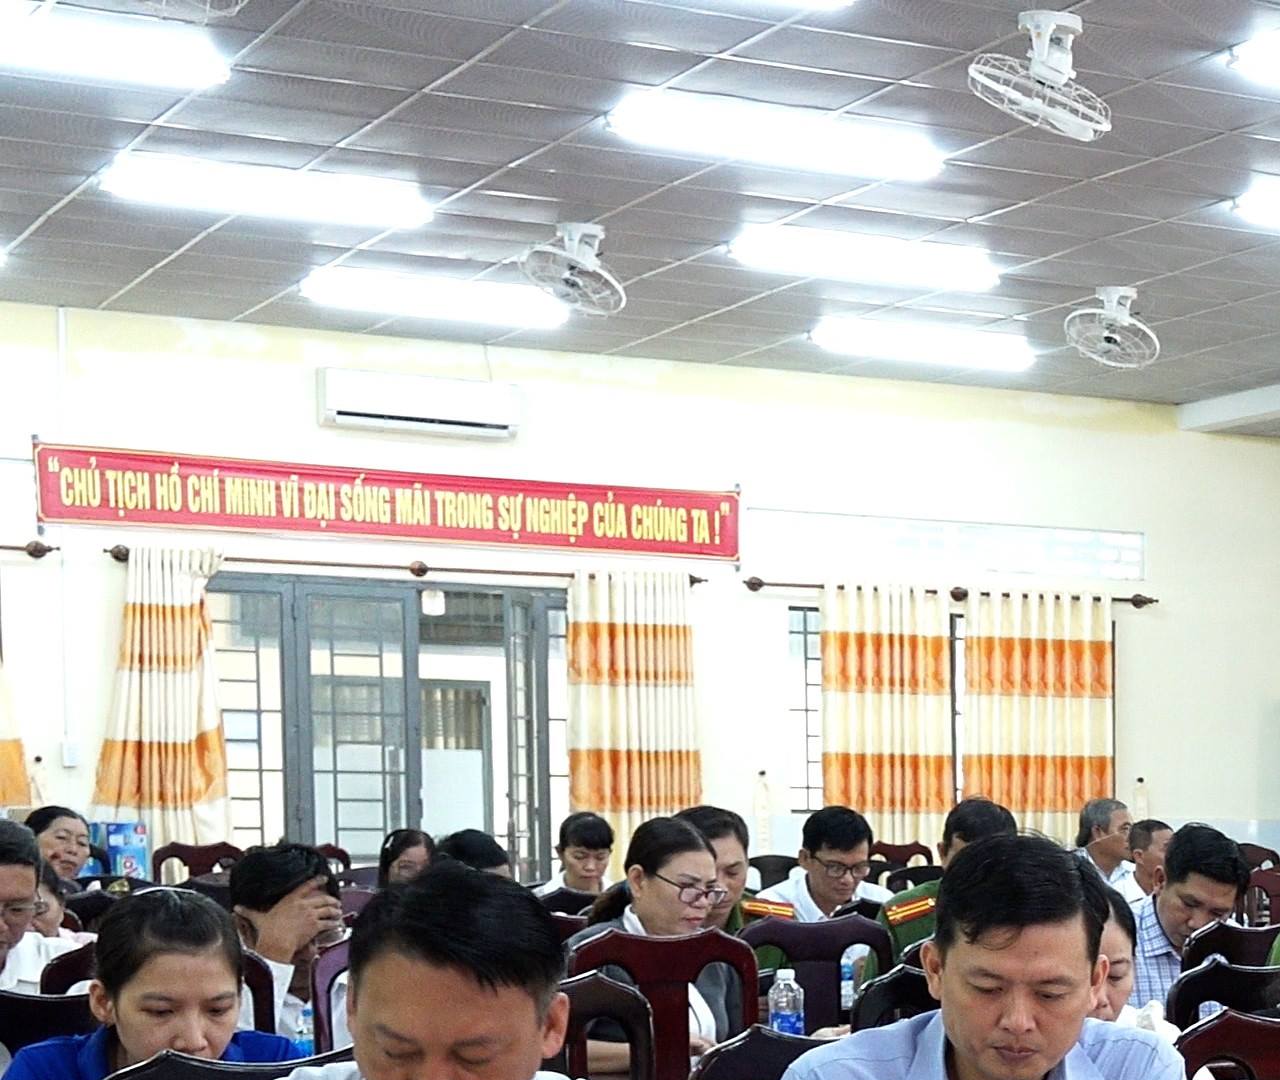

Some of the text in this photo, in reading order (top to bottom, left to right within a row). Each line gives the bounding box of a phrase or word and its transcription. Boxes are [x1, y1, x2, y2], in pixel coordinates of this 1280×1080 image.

[106, 470, 150, 517] TỊCH
[187, 469, 220, 514] CHÍ
[225, 476, 276, 517] MINH
[304, 482, 335, 527] ĐẠI
[340, 473, 390, 524] SỐNG
[395, 483, 430, 526] MÃI
[435, 490, 493, 529] TRONG
[498, 493, 523, 540] SỰ
[526, 493, 588, 543] NGHIỆP
[594, 491, 627, 539] CỦA
[631, 499, 687, 542] CHÚNG
[692, 509, 710, 544] TA
